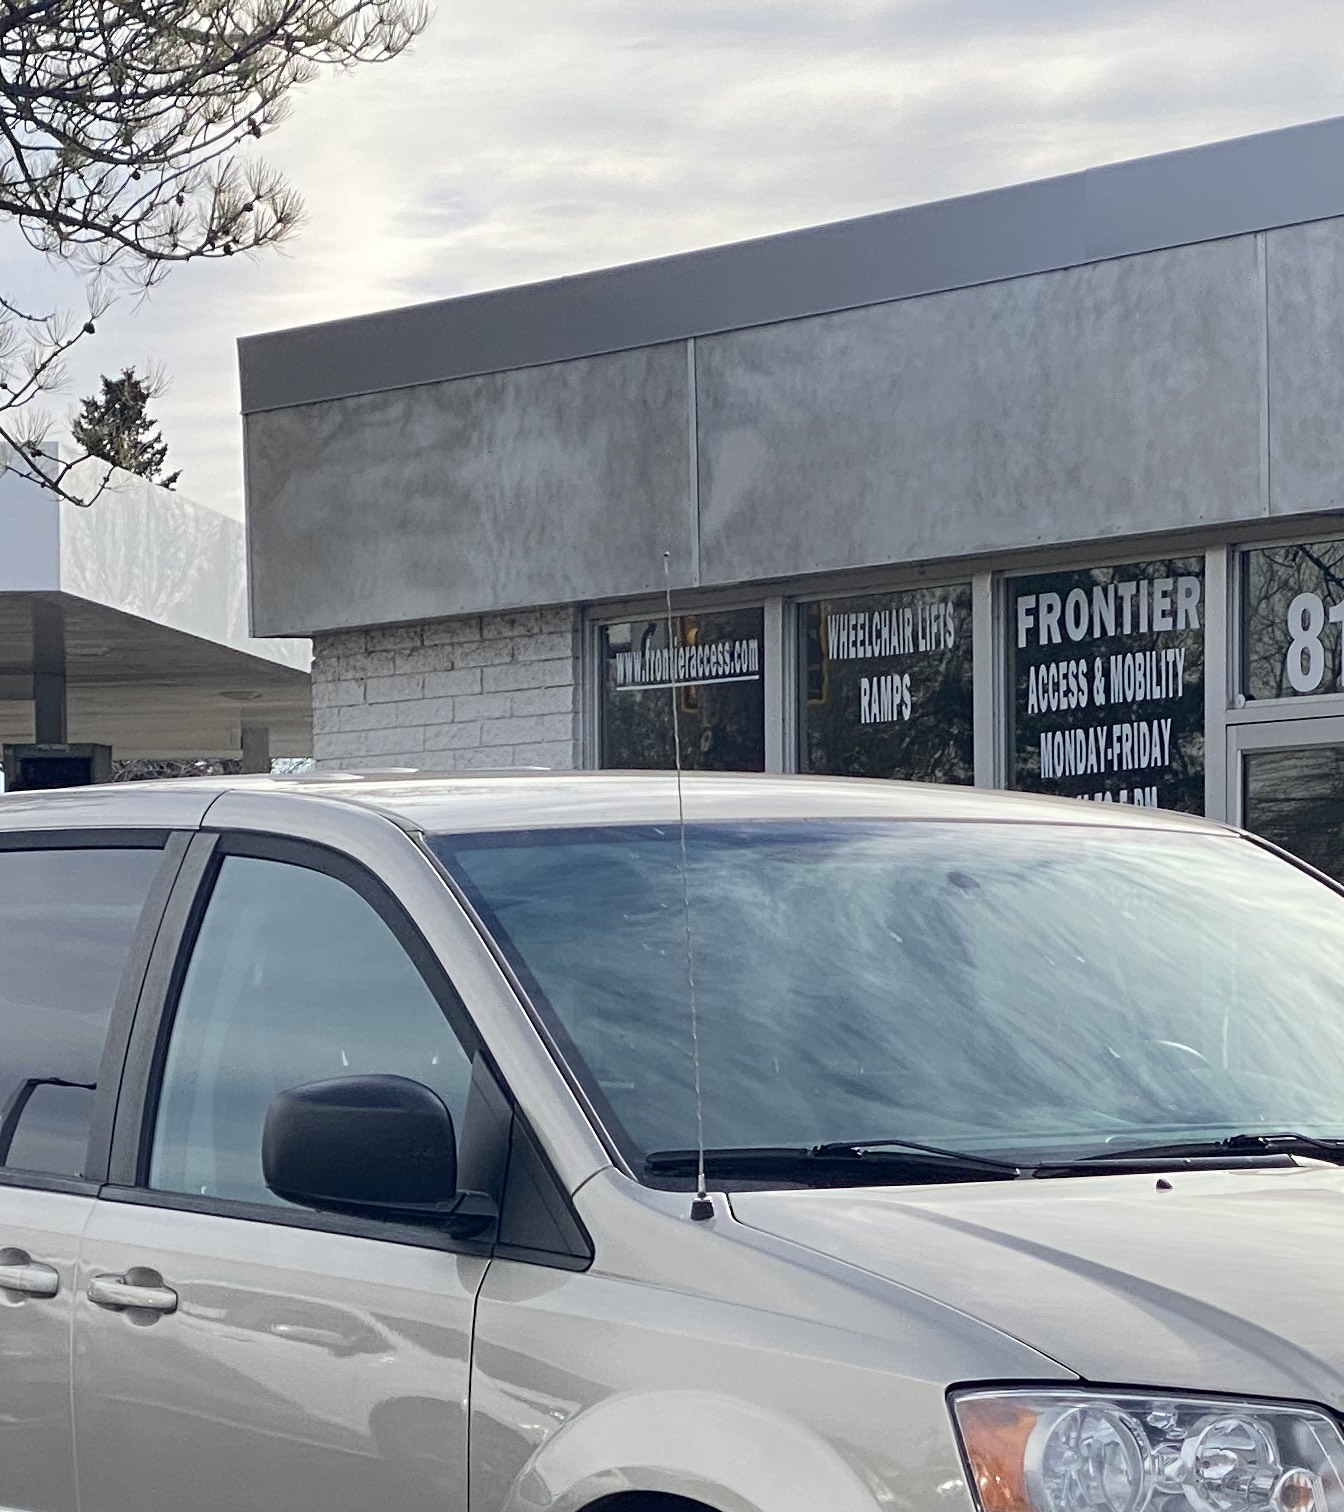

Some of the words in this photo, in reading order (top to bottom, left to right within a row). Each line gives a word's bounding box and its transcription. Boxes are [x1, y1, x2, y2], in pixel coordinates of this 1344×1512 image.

[827, 607, 914, 660] WHEELCHAIR
[918, 601, 955, 652] LIFTS
[1017, 576, 1201, 648] FRONTIER
[860, 673, 912, 724] RAMPS
[1027, 658, 1088, 715] ACCESS
[1093, 656, 1106, 707] &
[1110, 648, 1185, 704] MOBILITY
[1040, 718, 1172, 779] MONDAY-FRIDAY
